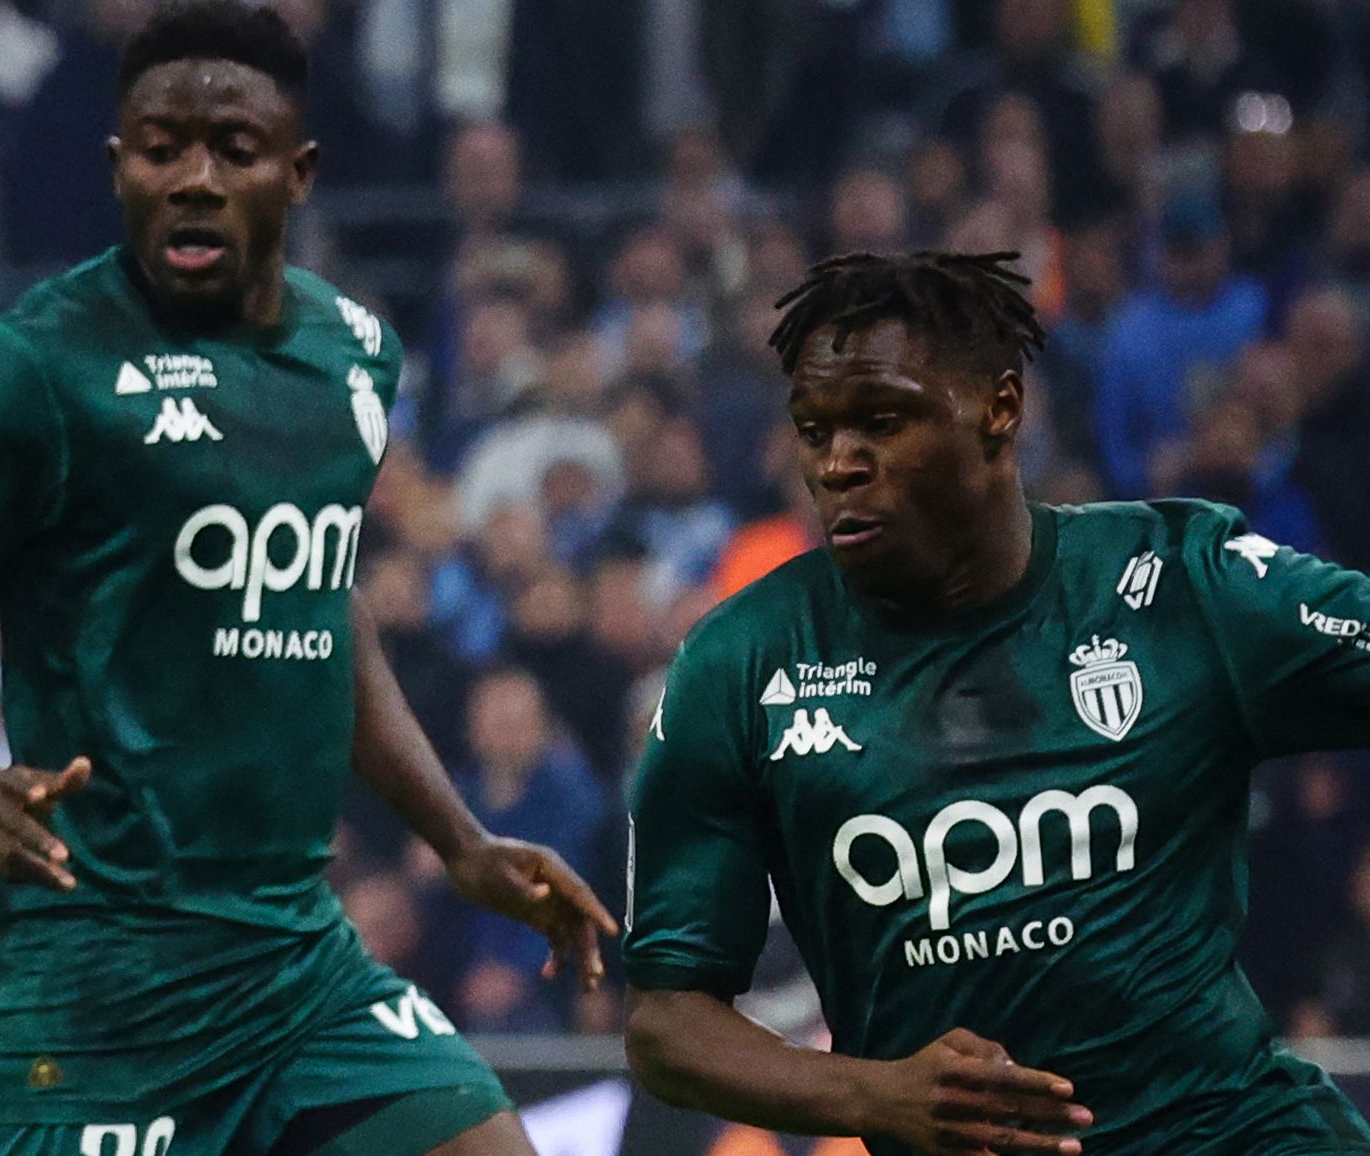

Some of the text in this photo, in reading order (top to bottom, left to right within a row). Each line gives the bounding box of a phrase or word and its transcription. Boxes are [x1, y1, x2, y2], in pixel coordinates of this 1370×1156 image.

[174, 502, 362, 622] apm
[1300, 602, 1370, 637] VRED
[213, 628, 333, 660] MONACO
[795, 656, 878, 681] Triangle
[798, 680, 872, 699] intérim
[832, 784, 1139, 931] apm
[903, 915, 1075, 968] MONACO
